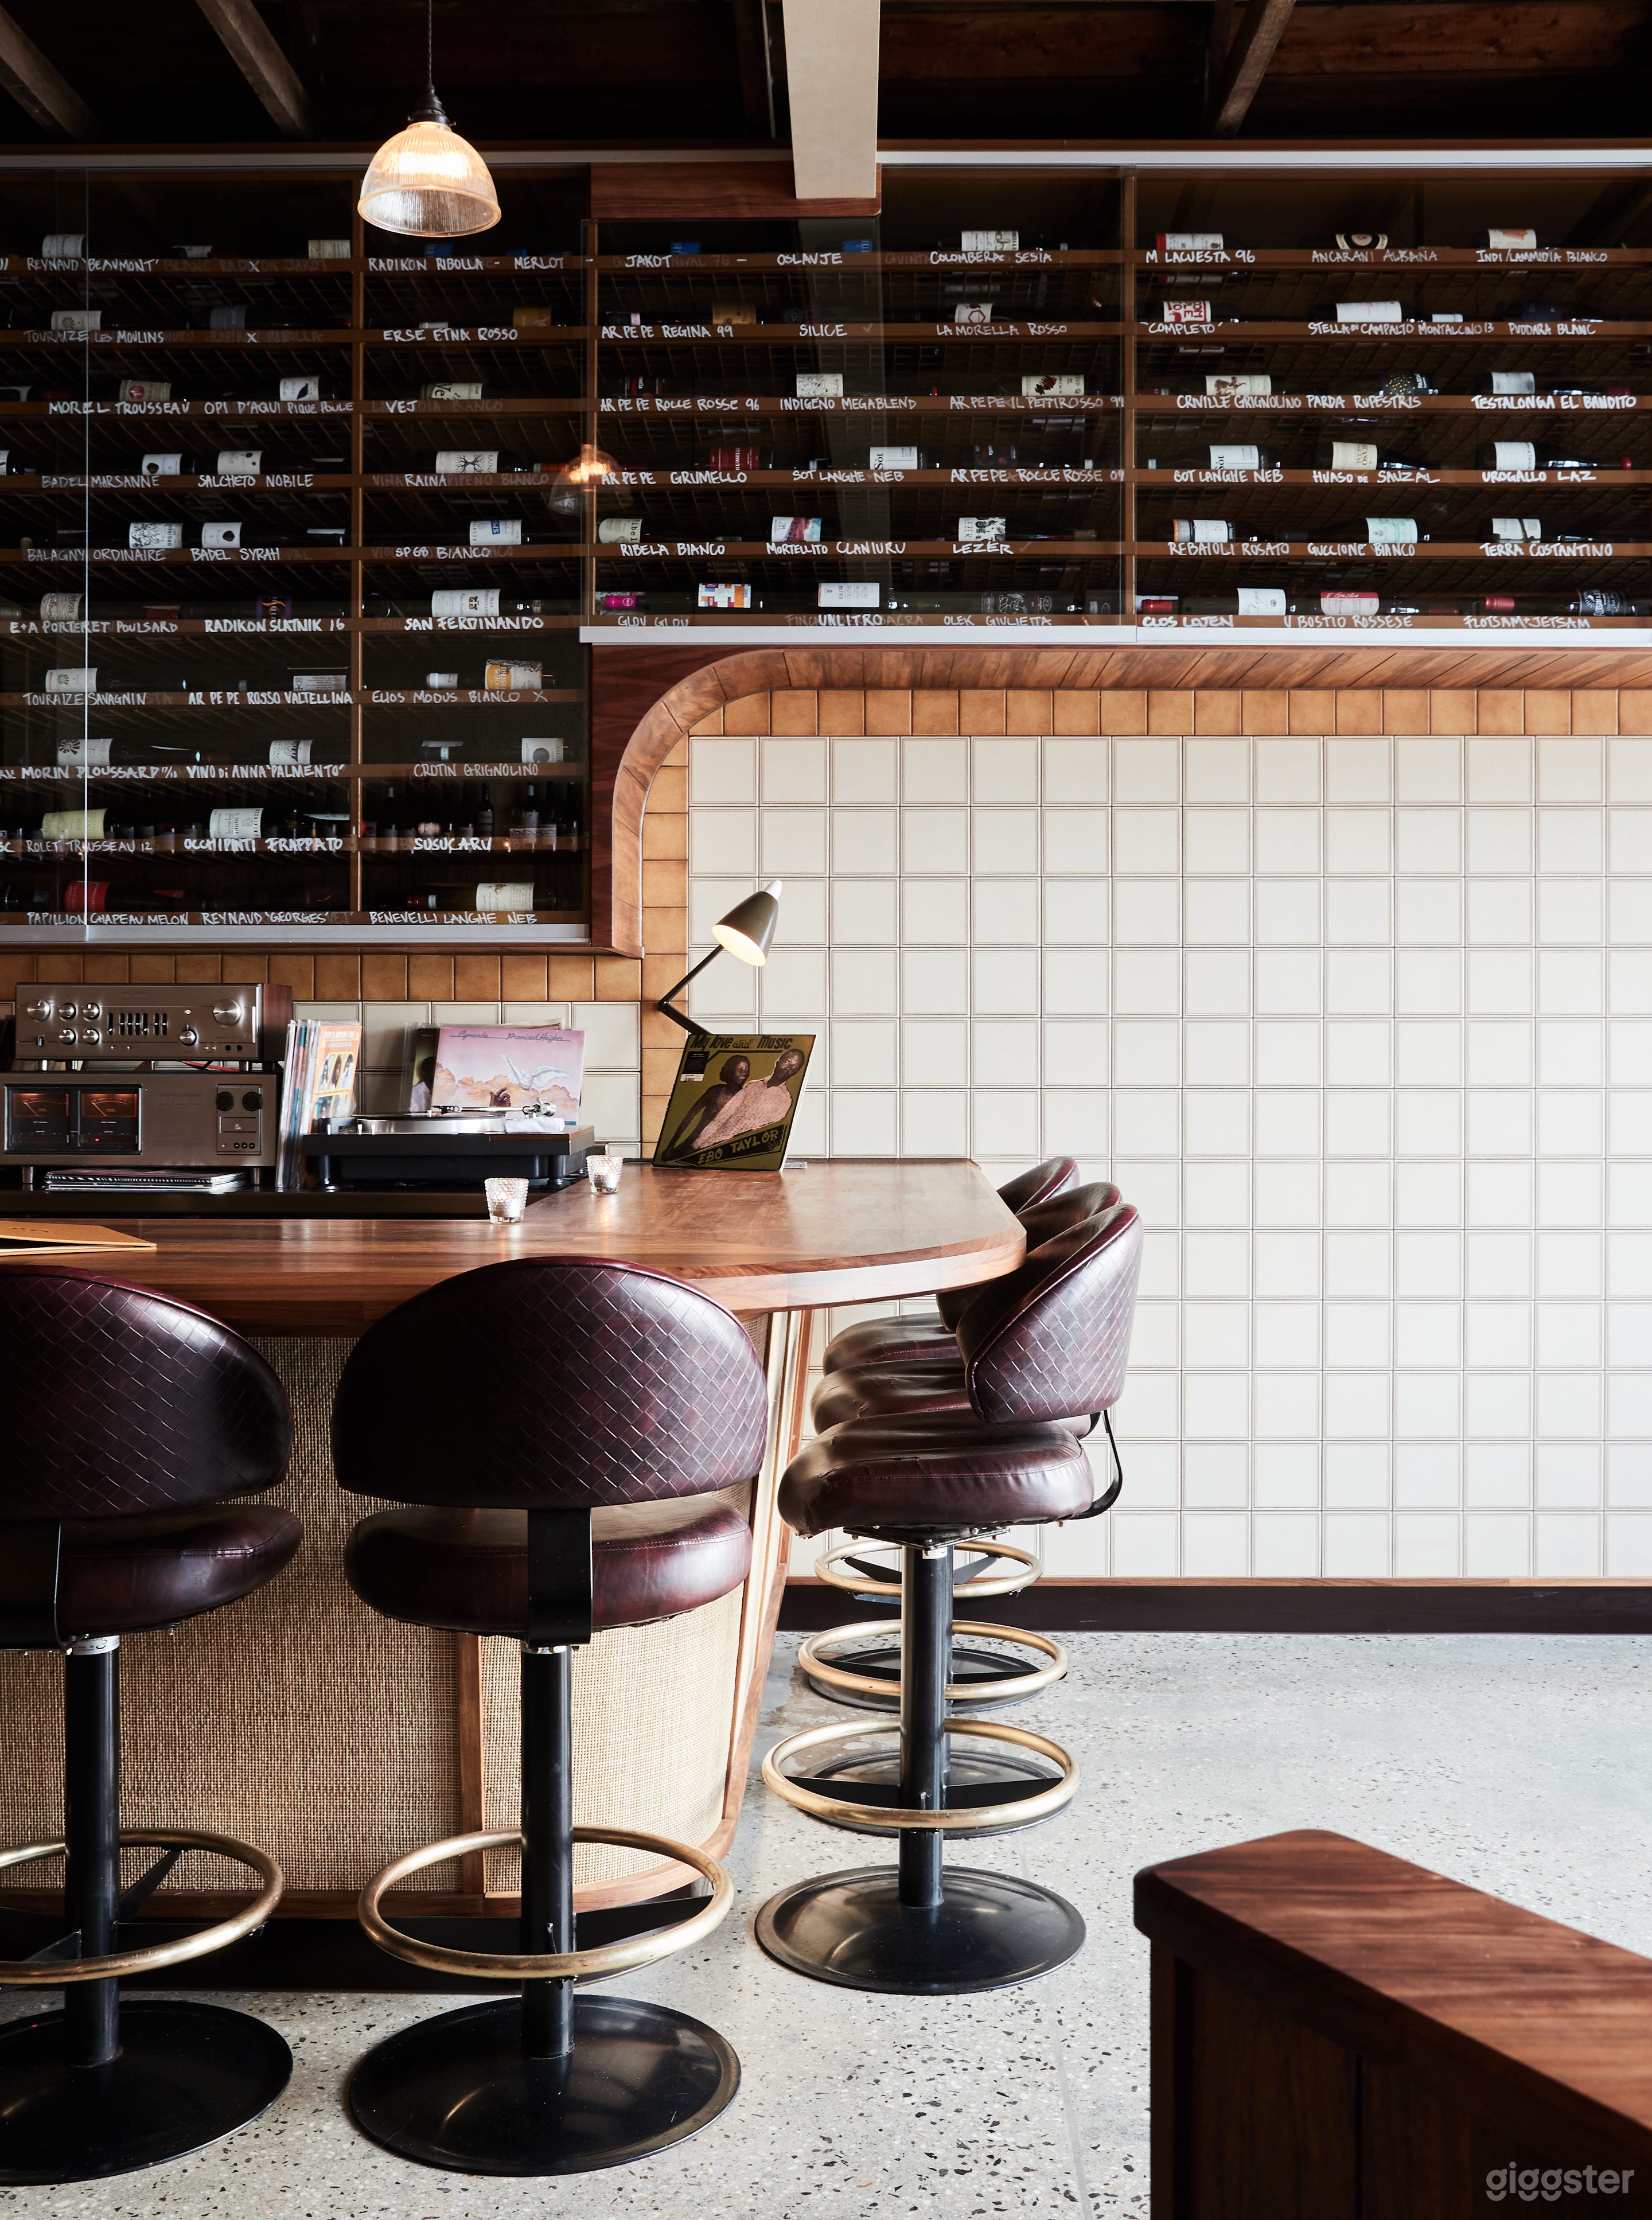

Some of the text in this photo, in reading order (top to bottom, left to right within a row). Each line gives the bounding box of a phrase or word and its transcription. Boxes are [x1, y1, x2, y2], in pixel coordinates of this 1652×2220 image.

[625, 255, 672, 267] JAKOT
[930, 251, 1004, 264] COLOMBERA
[1015, 252, 1052, 263] SESIA
[1146, 250, 1158, 263] M
[1235, 250, 1255, 263] 96
[1383, 249, 1437, 262] ALBANA
[1566, 251, 1607, 262] BIANCO
[368, 256, 564, 271] RADIKON RIBOLLA MERLOT
[383, 328, 517, 341] ERSE ETNA ROSSO
[602, 326, 623, 338] AR
[623, 326, 638, 338] PE
[641, 325, 654, 338] PE
[661, 325, 711, 338] REGINA
[800, 324, 847, 336] SILICE
[937, 322, 1067, 336] LA MORELLA ROSSO
[1361, 324, 1414, 335] CAMPALTO
[1418, 322, 1482, 335] MONTALCINO
[1557, 324, 1596, 335] BLANC
[116, 330, 164, 343] MOULINS
[115, 402, 190, 414] TROUSSEAU
[204, 402, 228, 414] OPI
[287, 402, 317, 414] PIQUE
[320, 401, 353, 414] POULE
[385, 400, 418, 413] VEJ
[600, 398, 759, 411] AR PE PE ROSSE 96
[780, 396, 916, 410] INDIGENO MEGABLEND
[950, 396, 970, 409] AR
[971, 397, 985, 408] PE
[987, 396, 1006, 408] PE
[1234, 395, 1302, 408] GRIGNOLINO
[1306, 395, 1421, 408] PARDA RUPESTRIS
[1471, 395, 1637, 409] TESTALONGA EL BANDITO
[91, 475, 159, 488] MARSANNE
[198, 474, 313, 488] SALCHETO NOBILE
[404, 474, 447, 486] RAINA
[601, 471, 747, 485] AR PE PE GRUMELLO
[792, 470, 904, 482] SOT LANGHE NEB
[951, 469, 969, 482] AR
[970, 469, 988, 482] PE
[989, 469, 1008, 482] PE
[1063, 469, 1102, 482] ROSSE
[1199, 469, 1283, 482] LANGHE NEB
[1312, 470, 1440, 483] HUASO SAUZAL
[1482, 471, 1596, 483] UROGALLO LAZ
[190, 547, 279, 561] BADEL SYRAH
[437, 547, 491, 559] BIANCO
[677, 542, 725, 555] BIANCO
[953, 541, 1014, 554] LEZER
[1241, 543, 1289, 555] ROSATO
[1373, 543, 1417, 556] BIANCO
[1479, 543, 1613, 556] TERRA COSTANTINO
[93, 548, 166, 561] ORDINAIRE
[204, 619, 266, 632] RADIKON
[330, 618, 345, 631] 16
[404, 617, 544, 630] SAN FERDINANDO
[944, 615, 1051, 626] OLEK GIULIETTA
[1298, 616, 1346, 628] BOSTIO
[1354, 616, 1412, 628] ROSSESE
[189, 691, 353, 704] AR PE PE ROSSO VALTELLINA
[413, 690, 520, 703] MODUS BIANCO
[21, 766, 70, 779] MORIN
[186, 765, 264, 778] VINO ANNA
[414, 764, 457, 777] CROTIN
[90, 913, 143, 924] CHAPEAU
[369, 912, 537, 924] BENEVELLI LANGHE NEB
[690, 1035, 711, 1051] My
[733, 1038, 754, 1049] and
[698, 1129, 779, 1165] EBO TAYLOR
